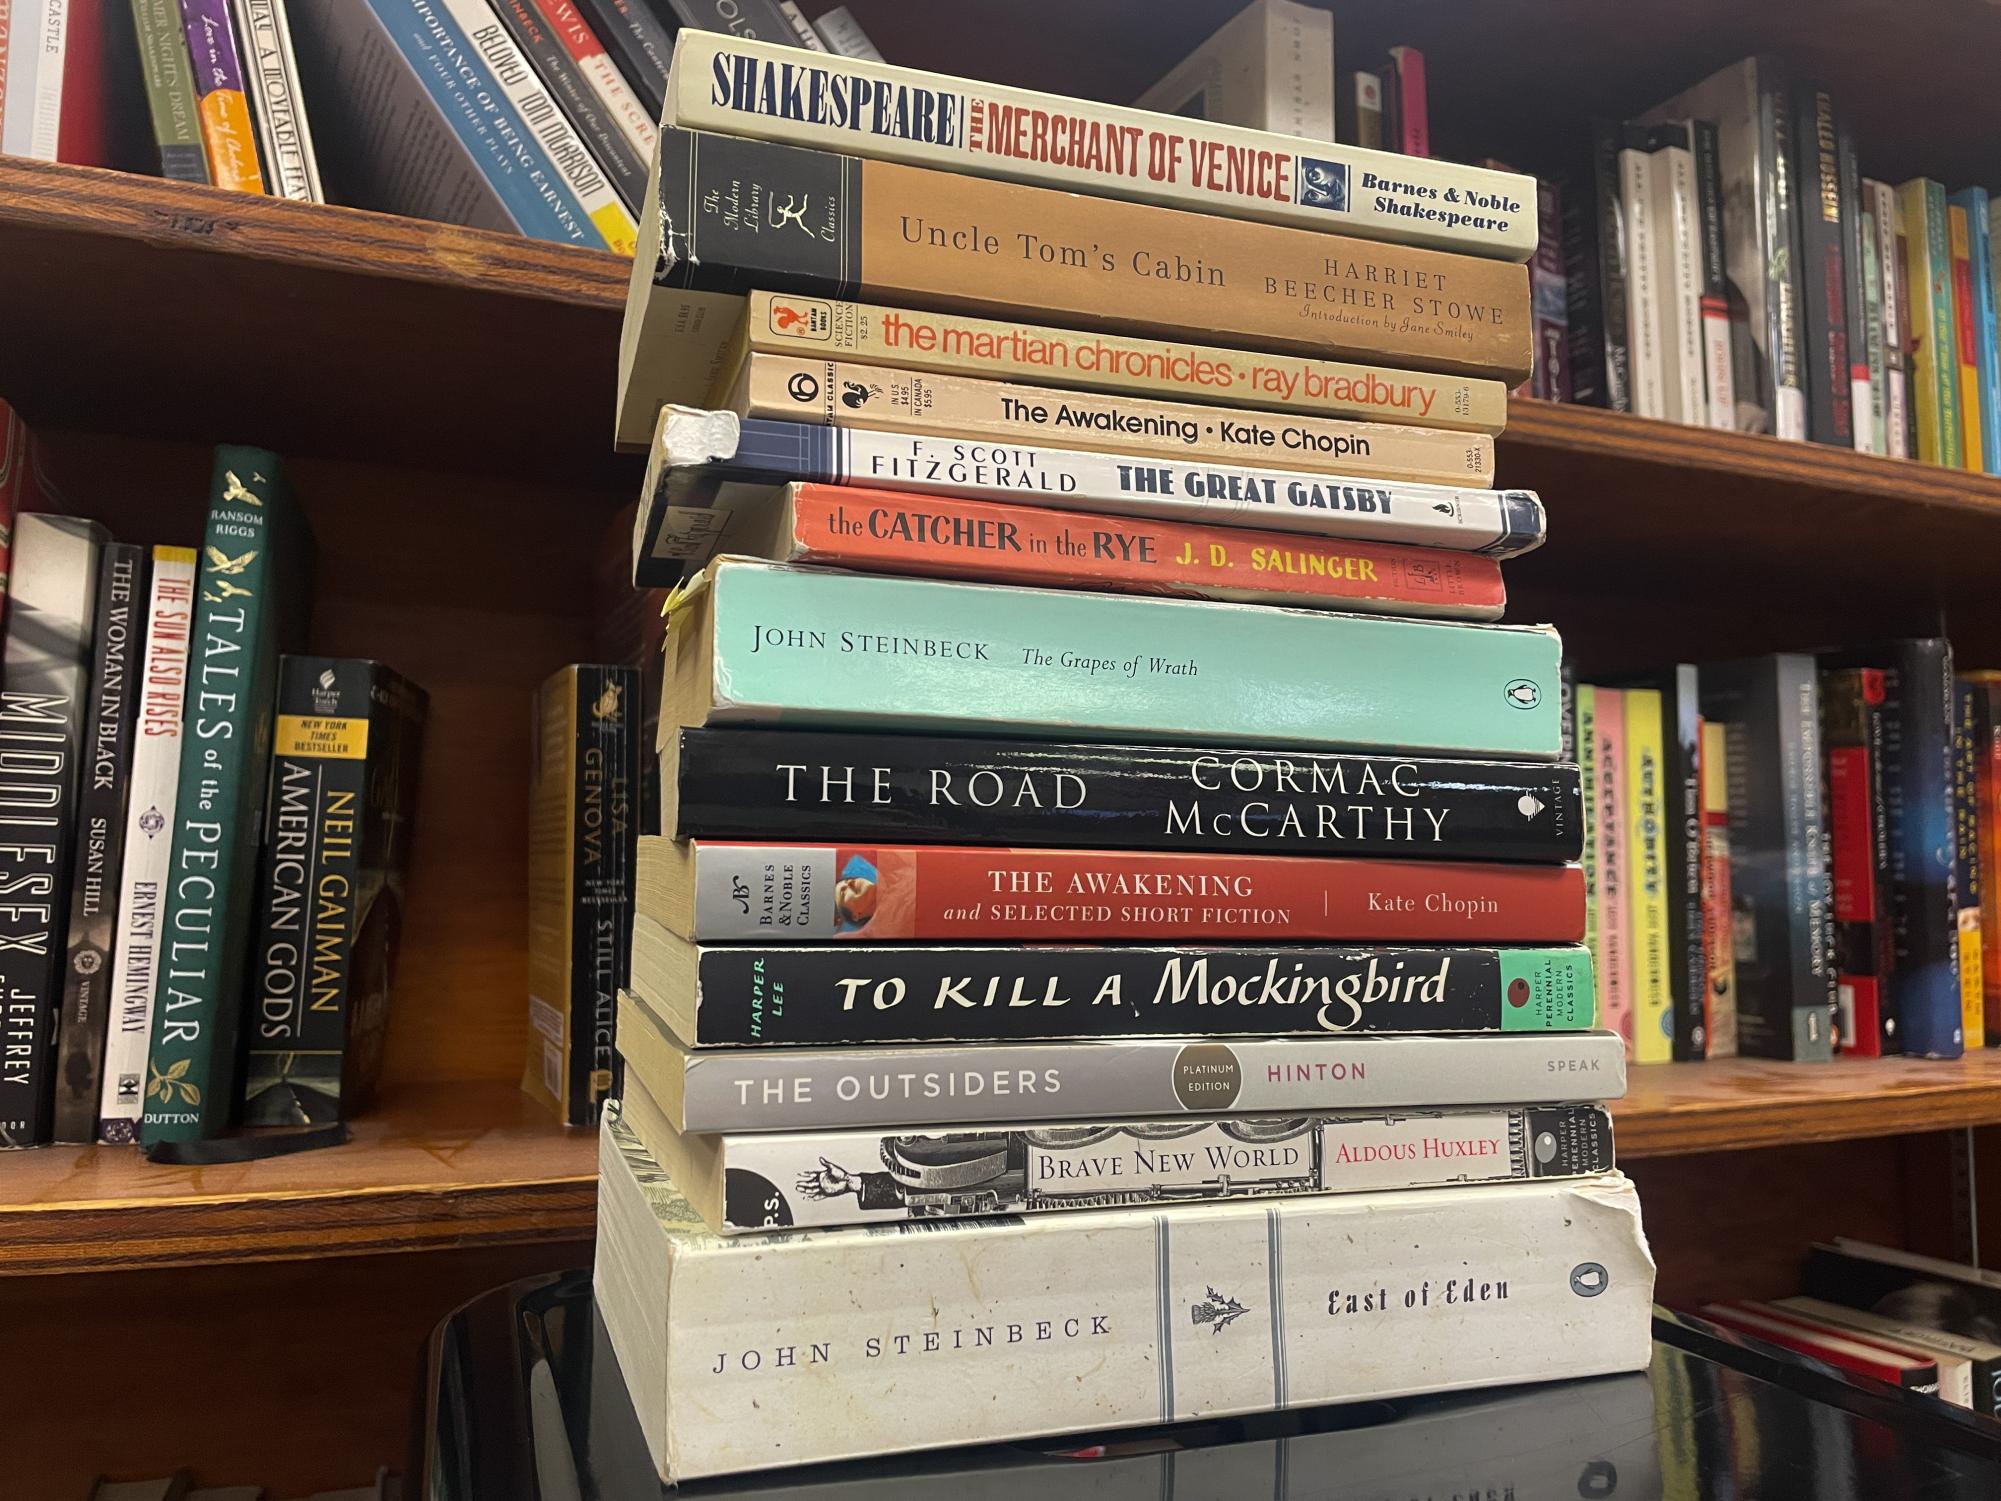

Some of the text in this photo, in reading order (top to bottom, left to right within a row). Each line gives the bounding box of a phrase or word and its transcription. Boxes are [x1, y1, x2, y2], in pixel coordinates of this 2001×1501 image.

[201, 14, 219, 45] Love
[629, 22, 646, 39] The
[595, 59, 623, 97] THE
[711, 51, 957, 148] SHAKESPEARE
[169, 92, 189, 141] DREAM
[428, 54, 513, 176] FOUR OTHER PLAYS
[473, 23, 605, 199] BELOVED TONI MORRISON
[476, 91, 584, 240] OF BEING EARNEST
[970, 98, 1291, 203] THE MERCHANT OF VENICE
[704, 189, 719, 214] The
[724, 180, 741, 231] Modern
[743, 183, 762, 233] Library
[1361, 172, 1521, 214] Barnes & Noble
[1818, 152, 1840, 223] HOSSEINI
[820, 196, 835, 242] Classics
[1373, 196, 1510, 233] Shakespeare
[900, 216, 1227, 287] Uncle Tom's Cabin
[1323, 258, 1447, 291] HARRIET
[835, 301, 845, 347] SCIENCE
[1264, 277, 1504, 325] BEECHER STOWE
[1299, 304, 1474, 342] Introduction by Jane Smiley
[844, 303, 854, 347] FICTION
[881, 313, 1436, 417] the martian chronicles ray bradbury
[914, 378, 922, 407] CANADA
[1001, 398, 1370, 458] The Awakening Kate Chopin
[872, 455, 1077, 492] FITZGERALD
[913, 441, 1036, 468] F. SCOTT
[1117, 465, 1392, 515] THE GREAT GATSBY
[211, 509, 263, 526] RANSOM
[215, 524, 256, 538] RIGGS
[827, 506, 1157, 563] the CATCHER in the RYE
[1175, 542, 1378, 582] J. D. SALINGER
[144, 578, 191, 738] THE SUN ALSO RISES
[750, 624, 990, 661] JOHN STEINBECK
[1022, 648, 1199, 678] The Grapes of Wrath
[94, 559, 133, 790] THE WOMAN IN BLACK
[776, 764, 1087, 810] THE ROAD
[1191, 755, 1420, 798] CORMAC
[162, 607, 245, 1046] TALES of the PECULIAR
[584, 747, 604, 865] GENOVA
[611, 777, 630, 833] LISA
[1554, 778, 1565, 837] VINTAGE
[1602, 738, 1618, 896] ACCEPTANCE
[84, 817, 107, 917] SUSAN HILL
[988, 870, 1253, 897] THE AWAKENING
[1823, 872, 1834, 906] JOY
[260, 760, 313, 1039] AMERICAN GODS
[310, 790, 356, 1013] NEIL GAIMAN
[760, 864, 775, 925] BARNES
[797, 865, 811, 926] CLASSICS
[944, 903, 1291, 924] and SELECTED SHORT FICTION
[1367, 892, 1499, 919] Kate Chopin
[121, 881, 157, 1034] ERNEST HEMINGWAY
[1809, 900, 1823, 977] MEMORY
[78, 980, 90, 1024] VINTAGE
[594, 920, 613, 1057] STILL ALICE
[750, 957, 765, 1038] HARPER
[771, 981, 785, 1017] LEE
[835, 957, 1451, 1031] TO KILL A Mockingbird
[1534, 971, 1543, 1016] HARPER
[1544, 960, 1553, 1027] PERENNIAL
[1555, 970, 1564, 1016] MODERN
[1566, 965, 1574, 1021] CLASSICS
[4, 989, 36, 1084] JEFFREY
[734, 1069, 1061, 1105] THE OUTSIDERS
[1183, 1063, 1235, 1075] PLATINUM
[1188, 1081, 1230, 1092] EDITION
[1267, 1062, 1366, 1082] HINTON
[1547, 1060, 1600, 1072] SPEAK
[144, 1113, 200, 1125] DUTTON
[1039, 1146, 1299, 1179] BRAVE NEW WORLD
[1335, 1138, 1500, 1164] ALDOUS HUXLEY
[1559, 1121, 1568, 1166] HARPER
[1579, 1119, 1588, 1166] MODERN
[1327, 1277, 1509, 1316] East of Eden
[712, 1315, 1110, 1374] JOHN STEINBECK
